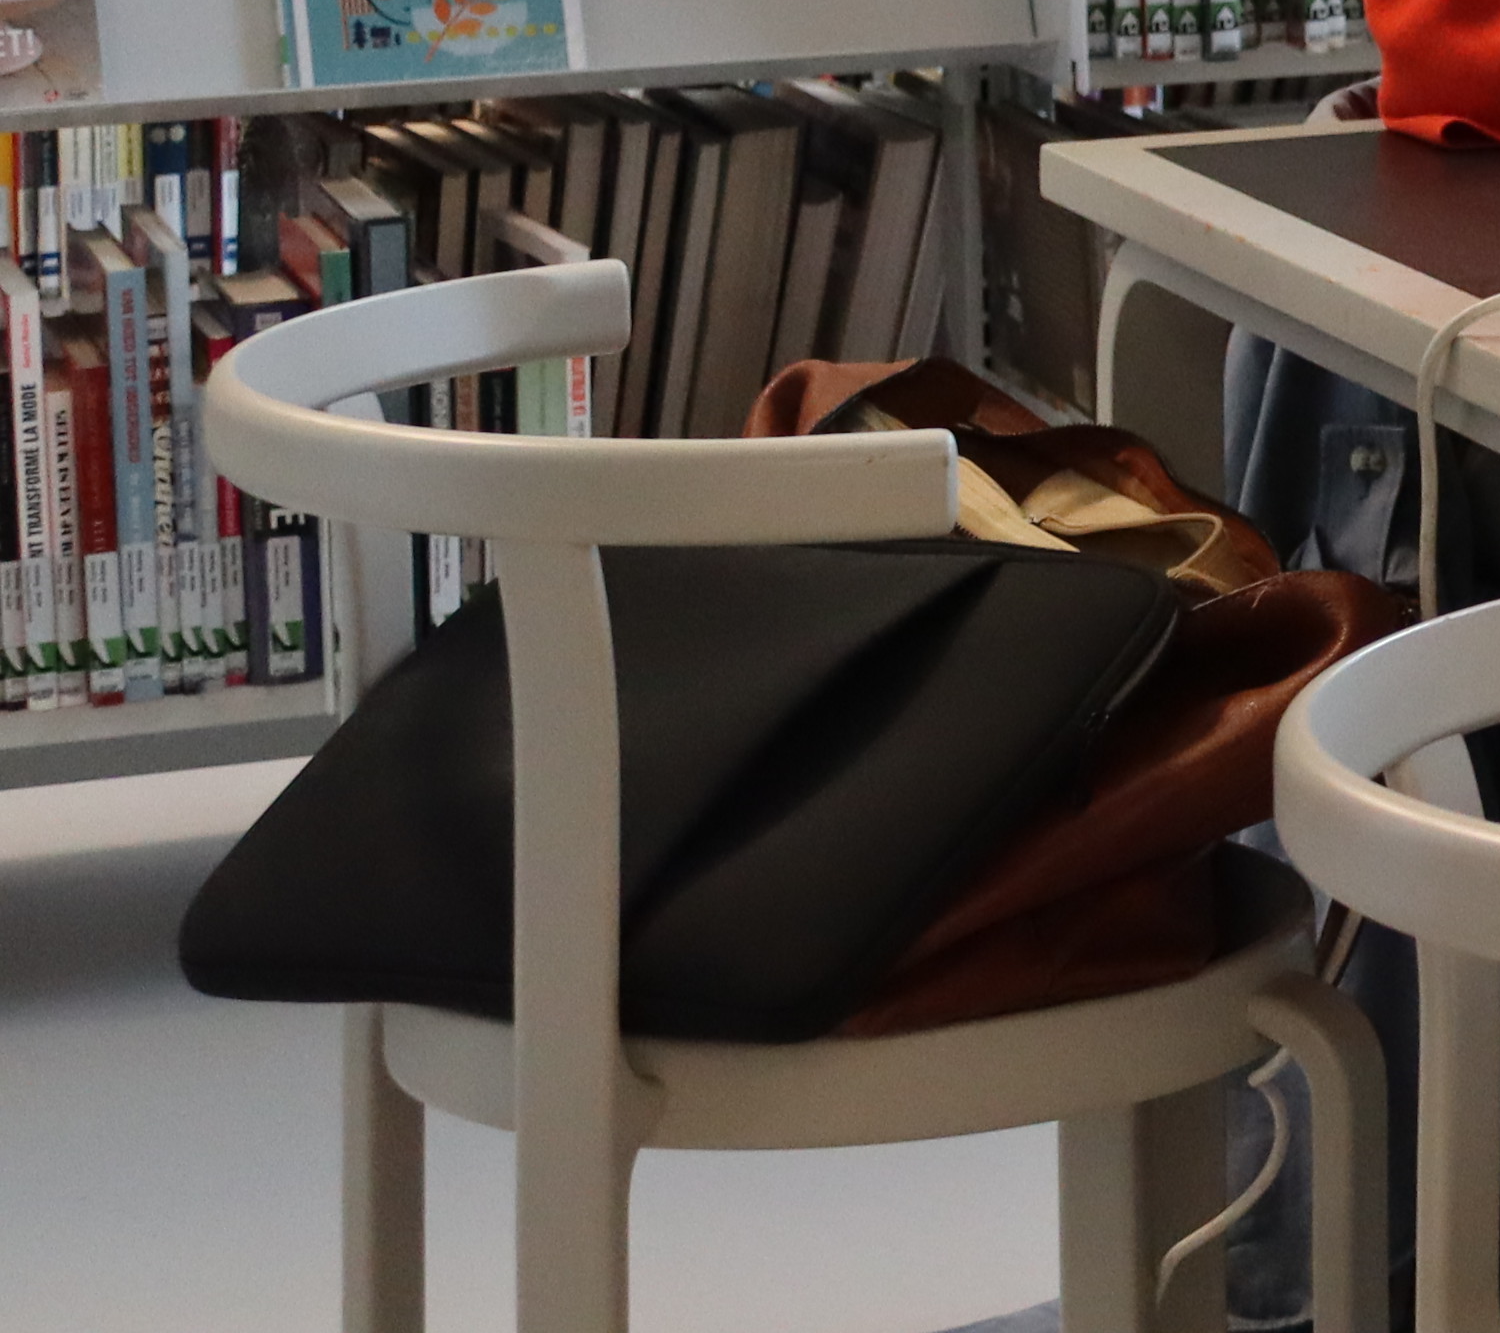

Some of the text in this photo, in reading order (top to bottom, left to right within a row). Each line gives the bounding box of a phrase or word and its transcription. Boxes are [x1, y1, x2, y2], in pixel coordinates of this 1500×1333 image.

[20, 382, 44, 537] TRANSFORMÉ LA MODE
